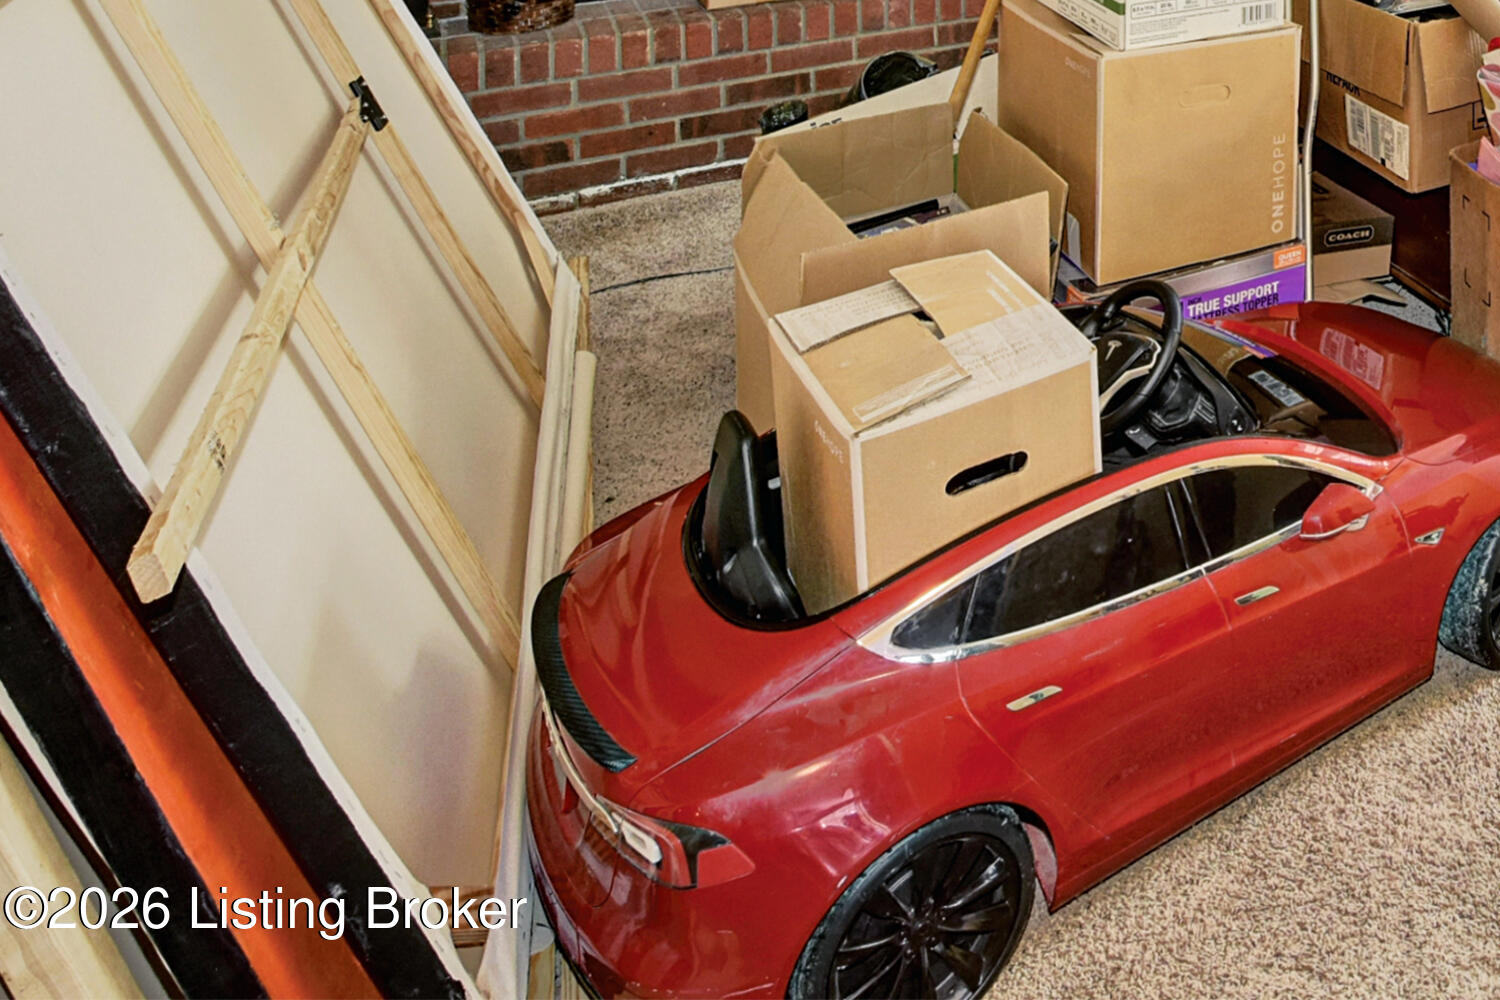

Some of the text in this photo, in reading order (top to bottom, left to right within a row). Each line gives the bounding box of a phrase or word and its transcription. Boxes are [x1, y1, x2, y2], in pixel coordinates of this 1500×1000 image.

[1271, 131, 1287, 234] ONEHOPE
[1328, 229, 1370, 243] COACH
[1187, 280, 1280, 318] TRUE SUPPORT
